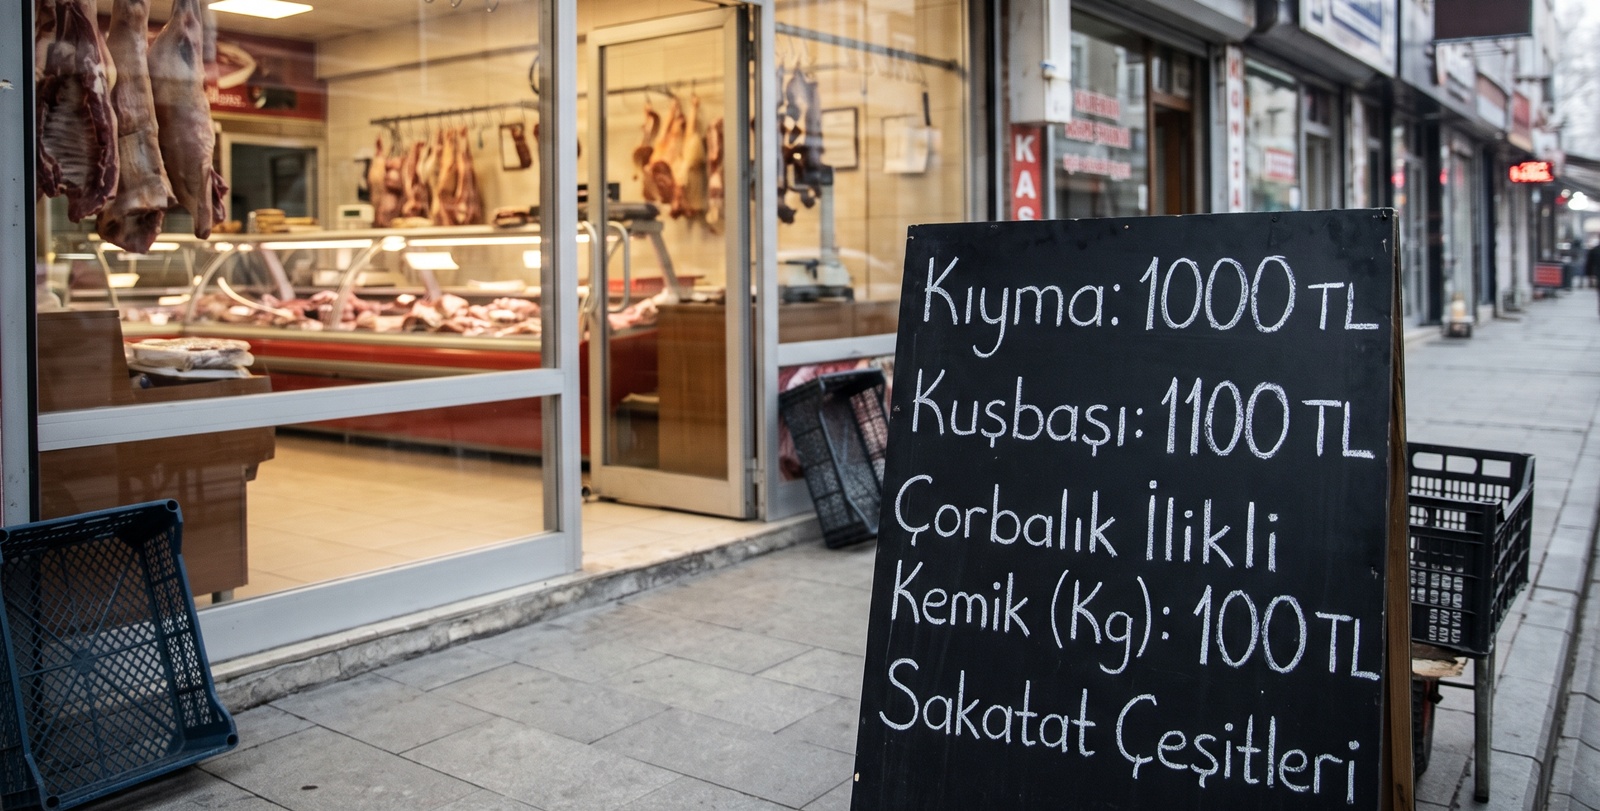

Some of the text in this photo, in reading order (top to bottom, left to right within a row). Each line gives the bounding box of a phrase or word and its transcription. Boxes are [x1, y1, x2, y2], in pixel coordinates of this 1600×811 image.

[923, 256, 1380, 358] Kıyma: 1000 TL
[912, 369, 1376, 460] Kuşbaşı: 1100 TL
[894, 475, 1279, 573] Çorbalık İlikli
[891, 559, 1381, 681] Kemik (Kg): 100 TL
[878, 658, 1360, 803] Sakatat Çeşitleri
